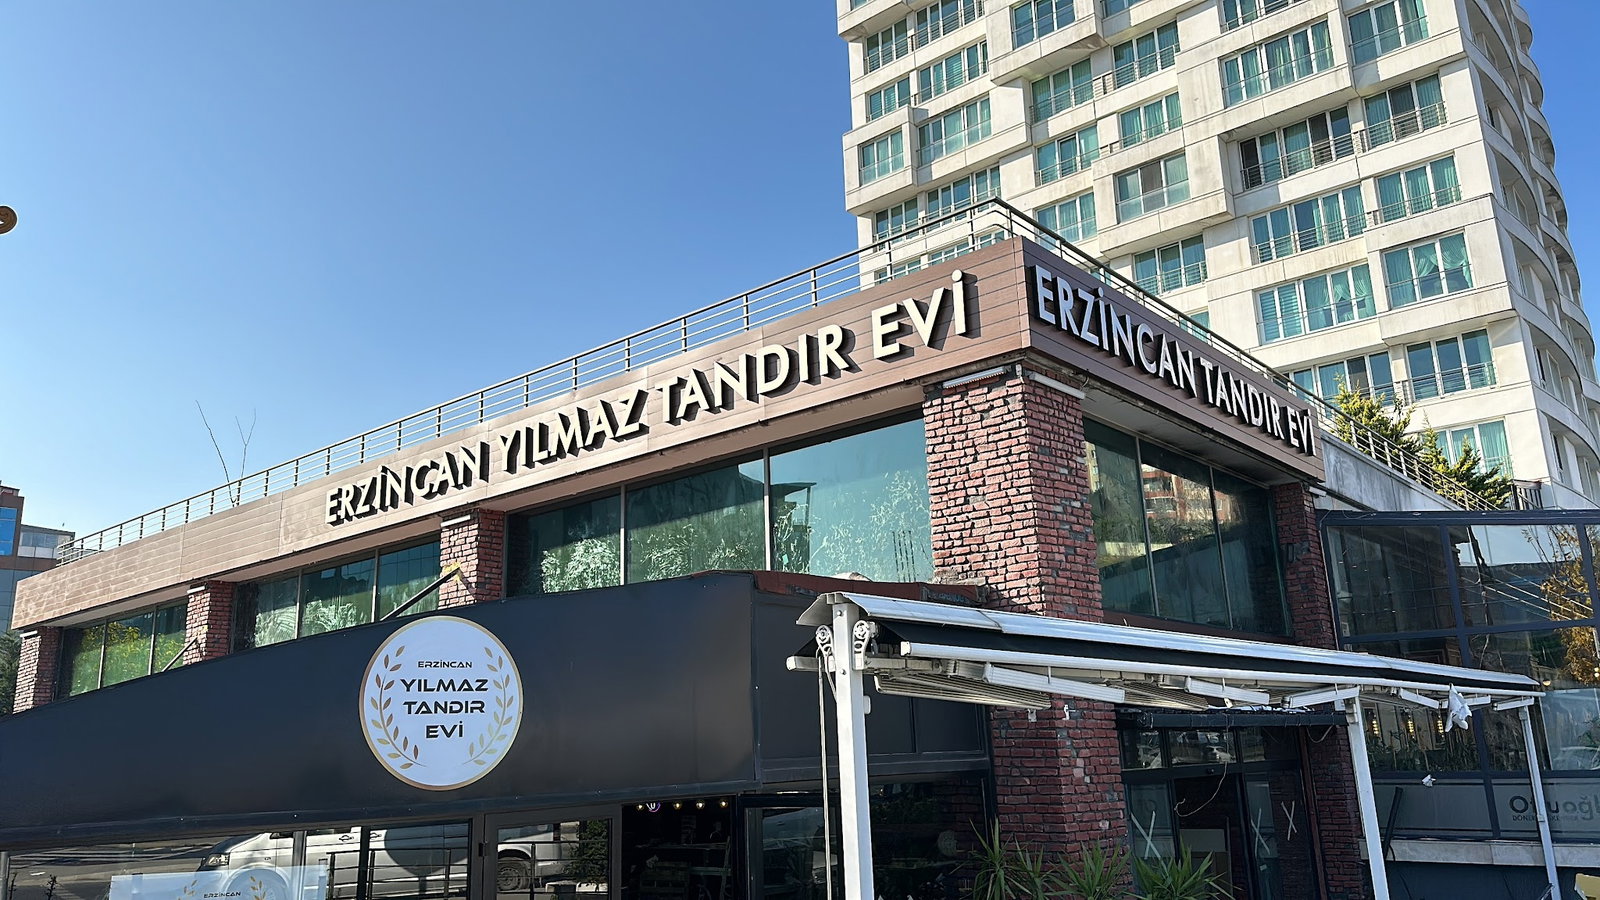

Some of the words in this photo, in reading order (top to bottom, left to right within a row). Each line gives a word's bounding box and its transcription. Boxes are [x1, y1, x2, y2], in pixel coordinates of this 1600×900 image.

[1034, 264, 1198, 398] ERZİNCAN
[1200, 358, 1285, 440] TANDIR
[1286, 405, 1317, 456] EVİ
[325, 441, 488, 525] ERZİNCAN
[497, 389, 648, 474] YILMAZ
[655, 324, 858, 424] TANDIR
[871, 269, 976, 361] EVİ
[417, 659, 472, 668] ERZİNCAN
[400, 678, 489, 692] YILMAZ
[403, 700, 485, 715] TANDIR
[425, 720, 464, 739] EVİ
